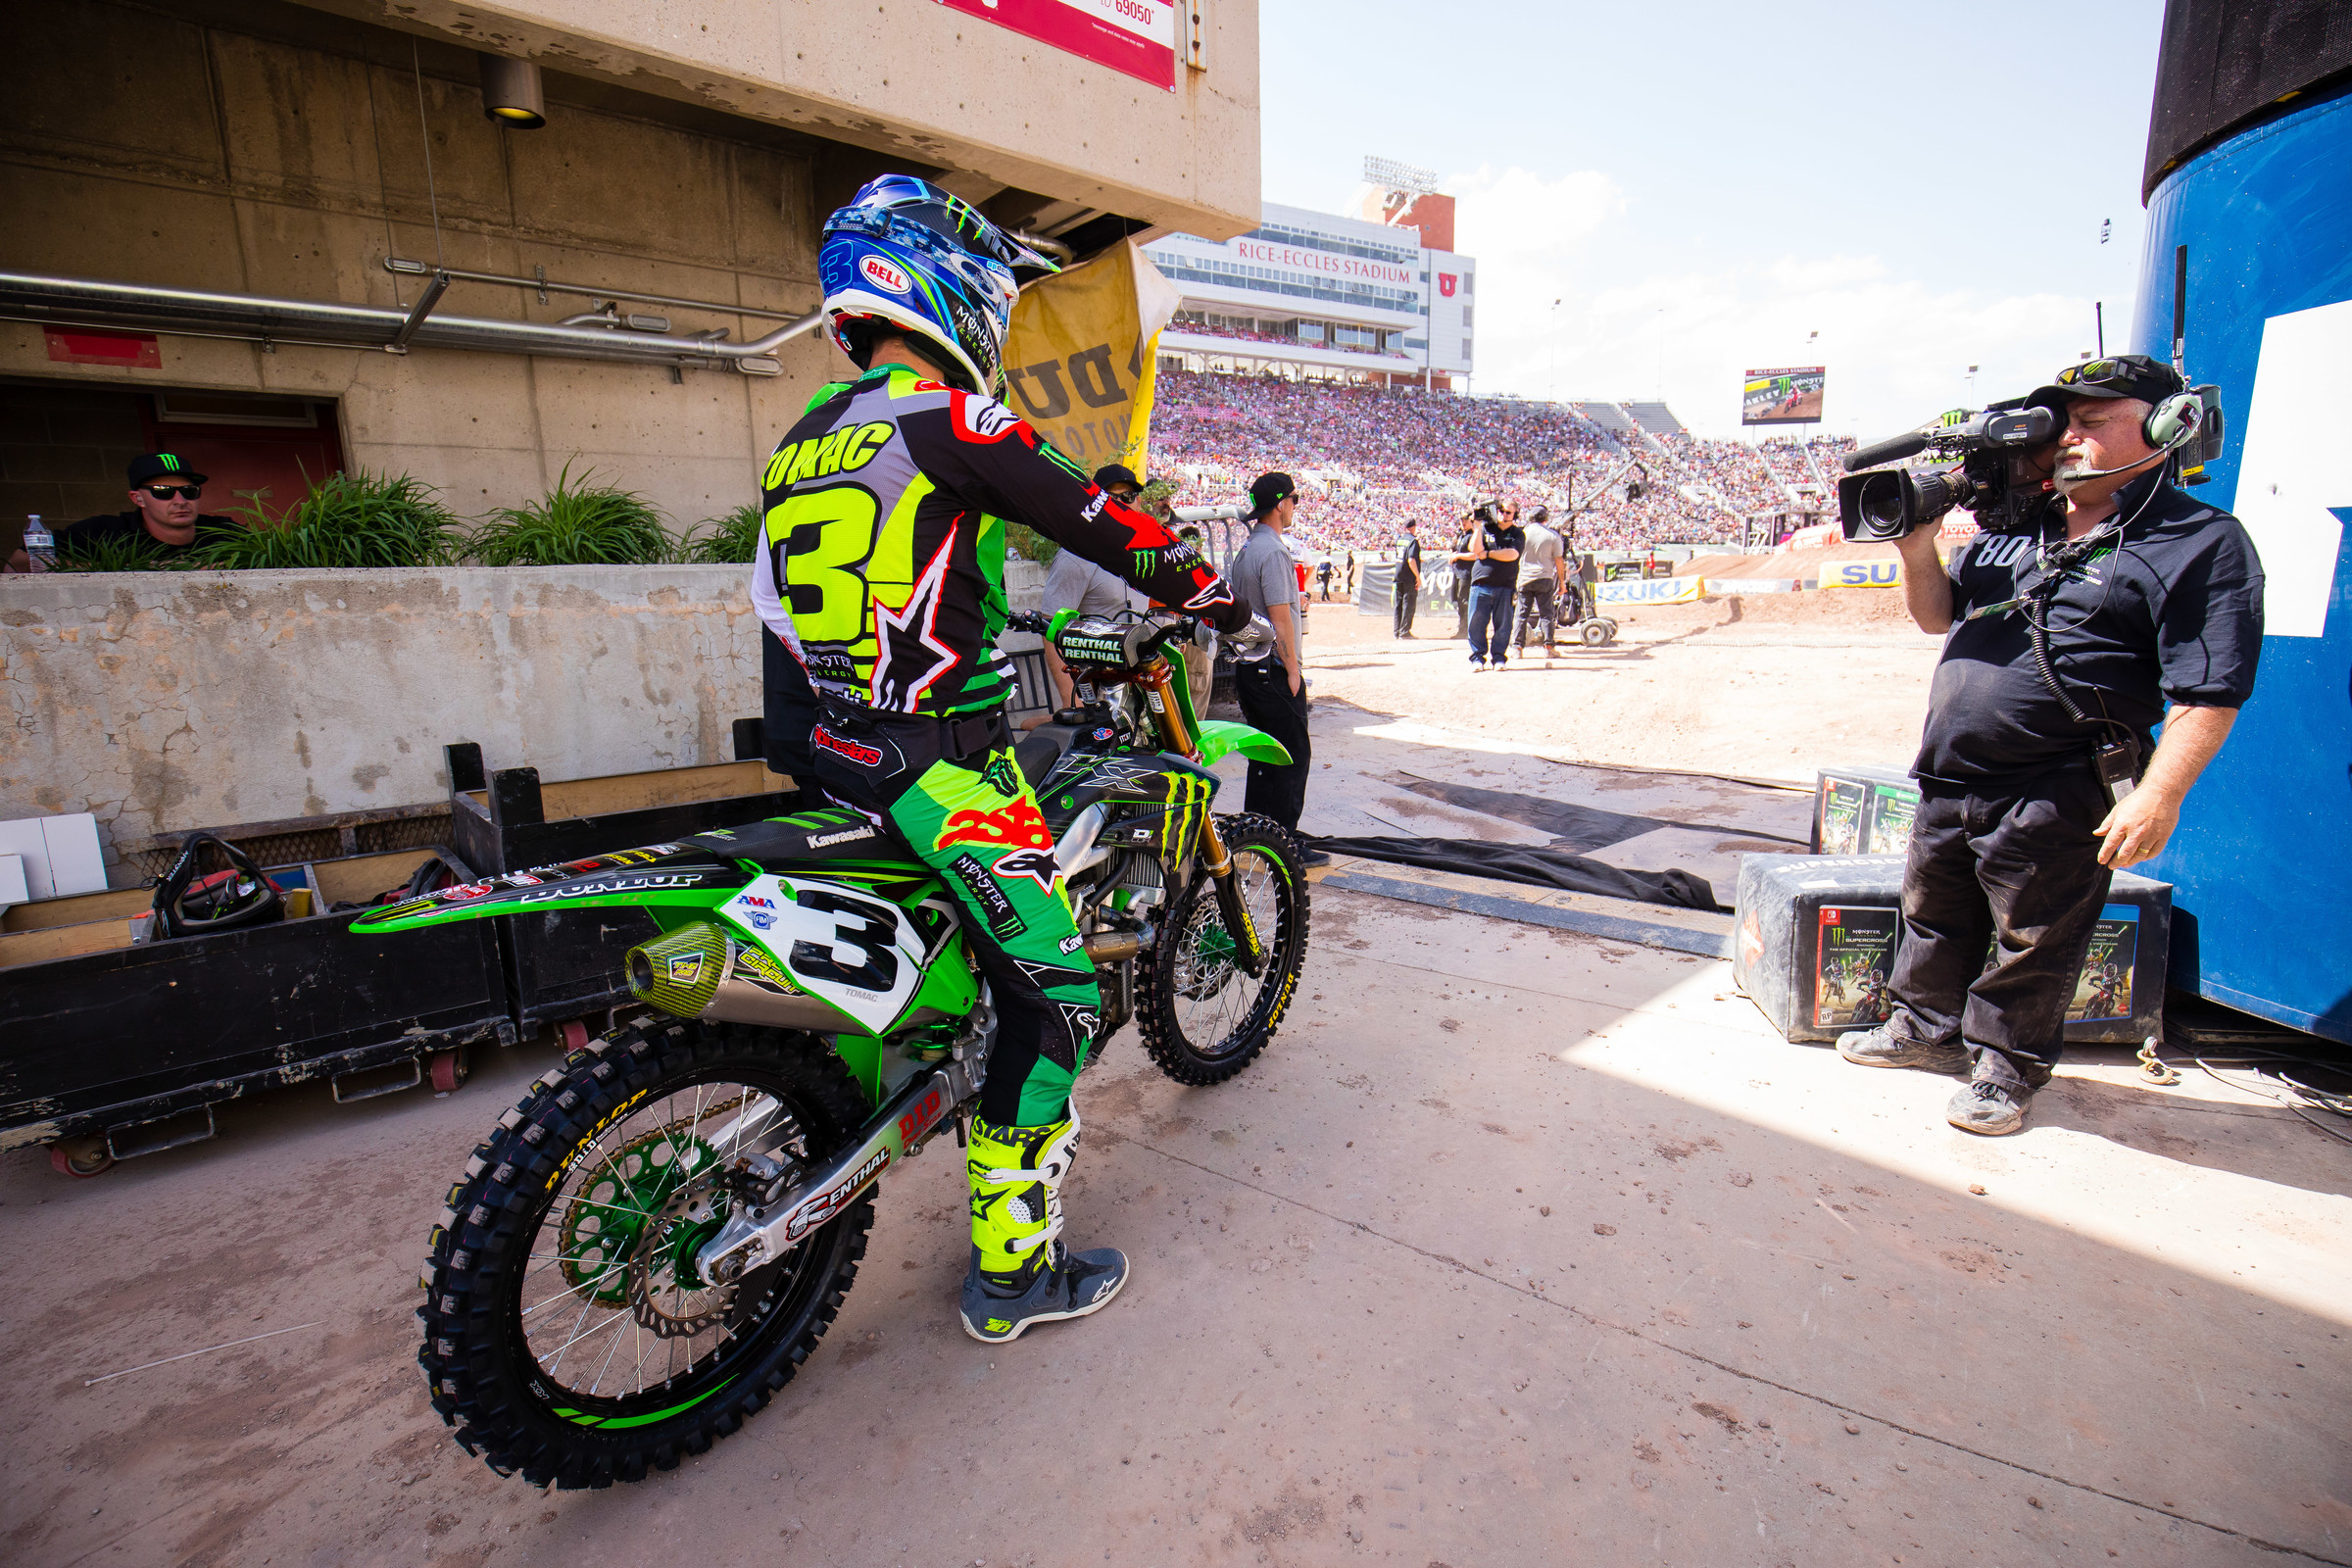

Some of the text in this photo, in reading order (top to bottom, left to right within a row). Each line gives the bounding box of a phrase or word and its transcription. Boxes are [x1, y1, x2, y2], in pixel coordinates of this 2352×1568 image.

[866, 261, 902, 289] BELL
[1240, 242, 1411, 284] RICE-ECCLES STADIUM
[1439, 272, 1457, 297] U
[1743, 389, 1780, 407] AKLEY
[766, 487, 877, 641] 3
[1062, 636, 1121, 652] RENTHAL
[1064, 648, 1124, 663] RENTHAL
[806, 825, 876, 850] Kawasaki
[520, 873, 703, 905] DUNLOP
[737, 895, 778, 910] AMA
[756, 915, 768, 924] FIM
[790, 890, 899, 992] 3
[845, 988, 878, 1003] TOMAC
[1268, 972, 1295, 1029] DUNLOP
[545, 1089, 648, 1193] DUNLOP
